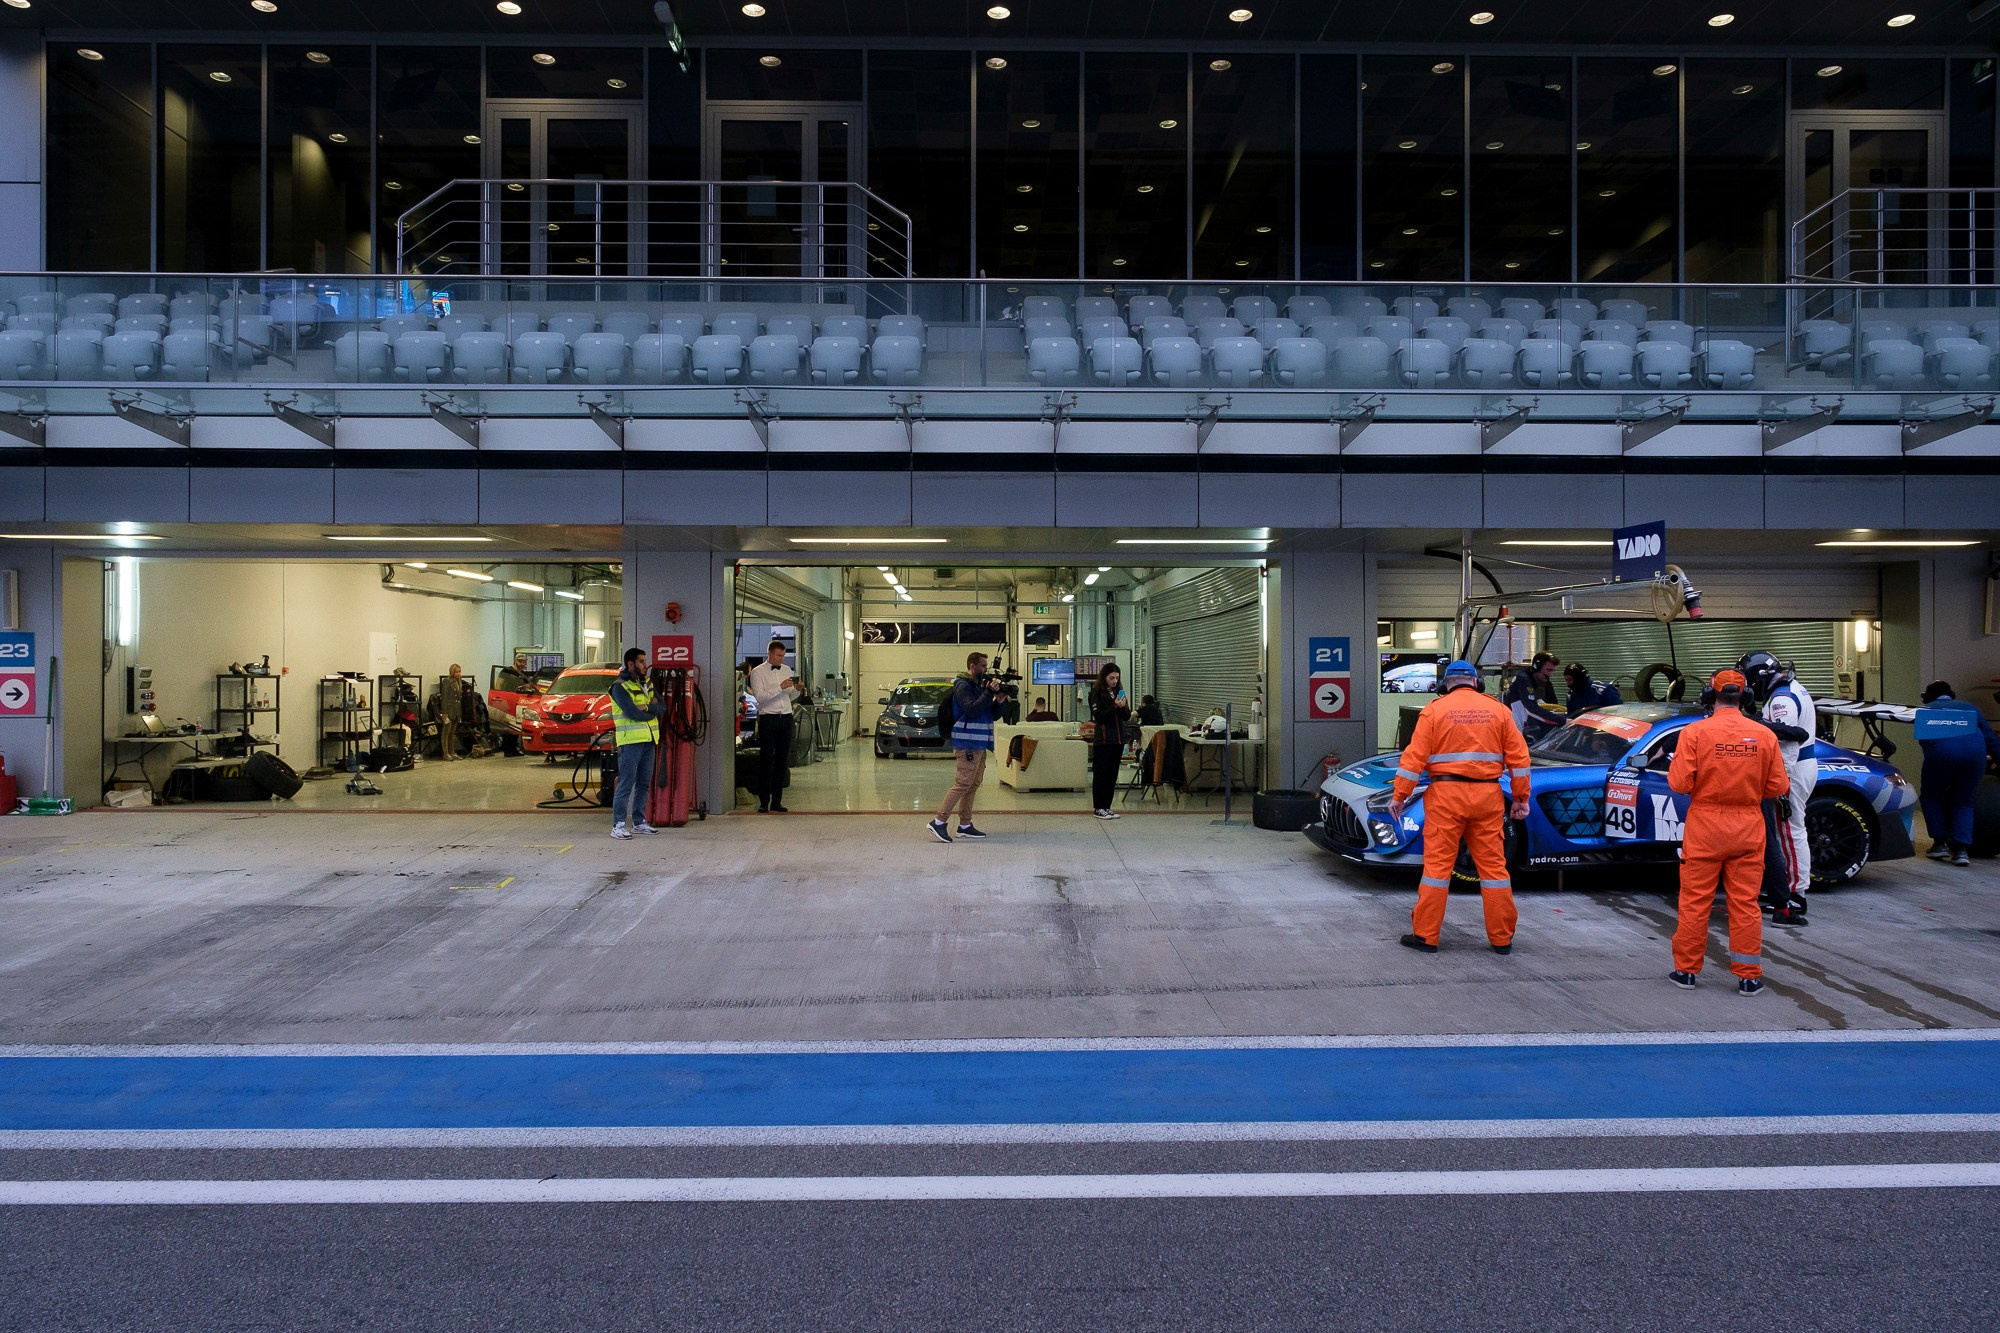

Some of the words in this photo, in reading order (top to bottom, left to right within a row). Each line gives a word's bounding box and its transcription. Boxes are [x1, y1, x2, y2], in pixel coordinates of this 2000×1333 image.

[1617, 534, 1661, 560] YADRO
[0, 644, 29, 657] 23
[658, 647, 688, 660] 22
[1316, 648, 1342, 662] 21
[1715, 744, 1758, 752] SOCHI
[1606, 806, 1636, 834] 48
[1835, 802, 1869, 833] PIRELLI
[1530, 856, 1579, 865] yadro.com
